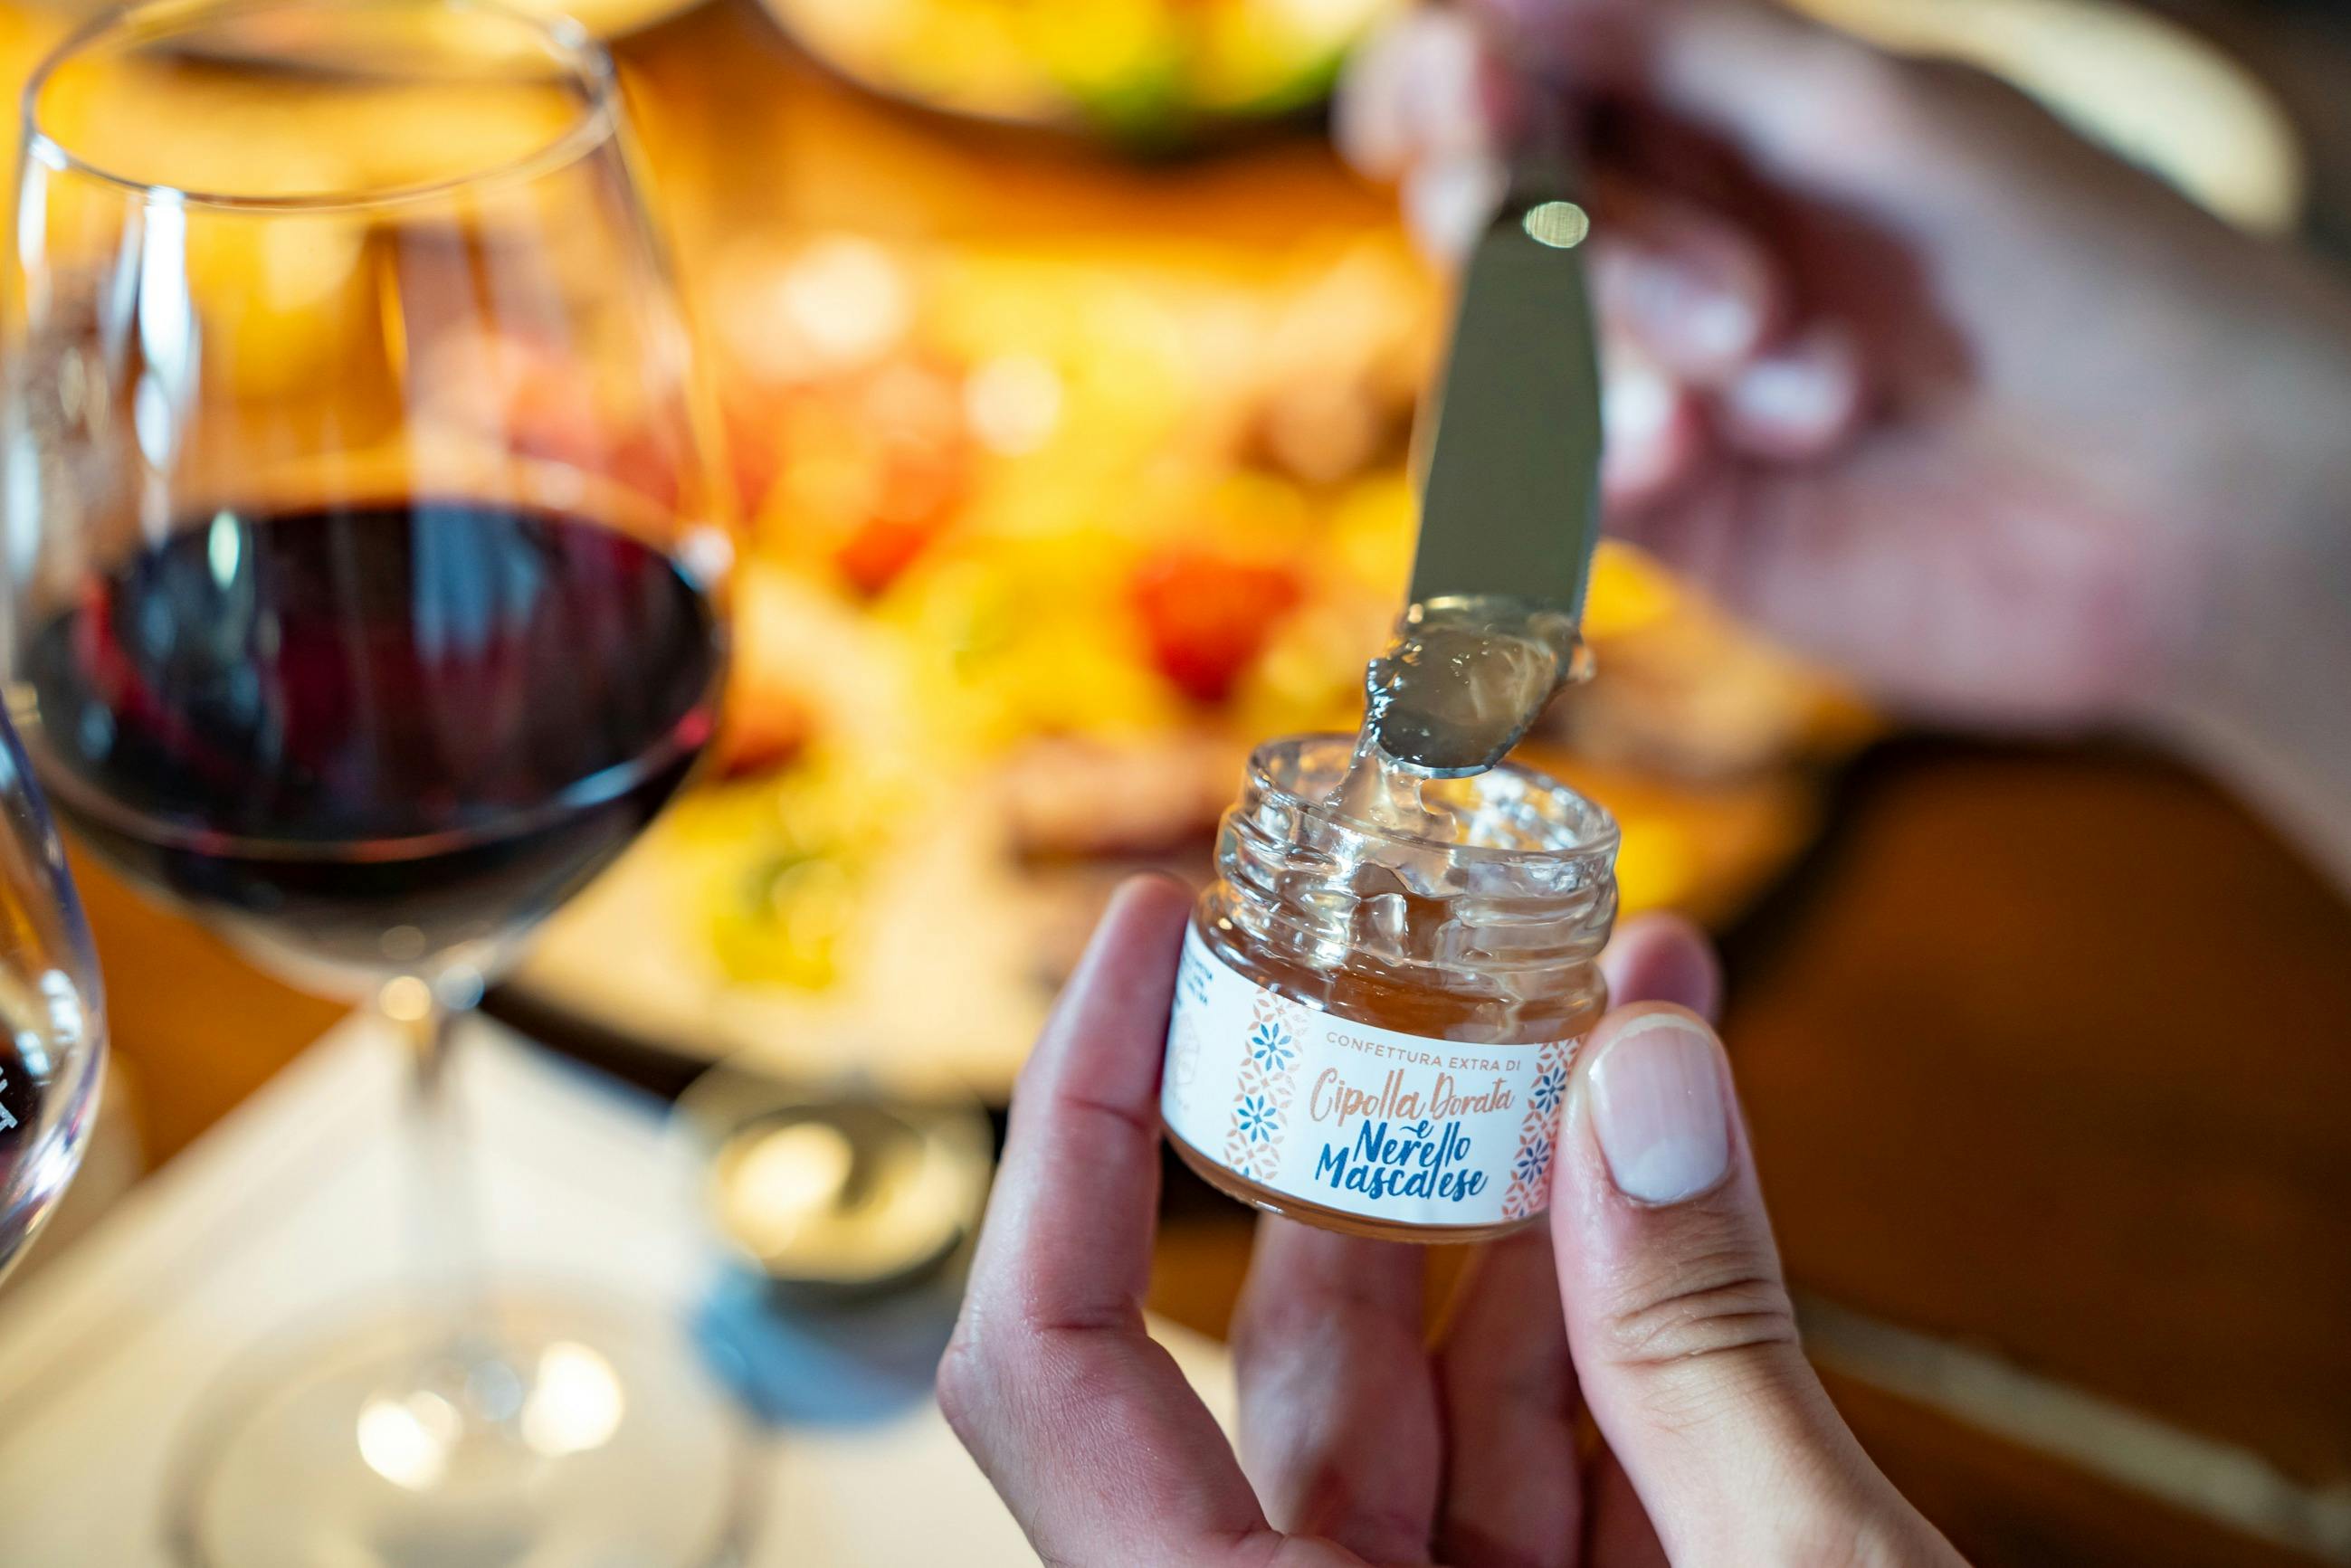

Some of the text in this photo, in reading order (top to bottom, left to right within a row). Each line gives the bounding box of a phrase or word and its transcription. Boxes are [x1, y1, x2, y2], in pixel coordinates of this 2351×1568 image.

[1326, 1031, 1520, 1071] CONFETTURA EXTRA DI
[1309, 1067, 1515, 1126] Cipolla Dorata
[1353, 1119, 1471, 1168] Nerello
[1315, 1143, 1489, 1202] Mascalese
